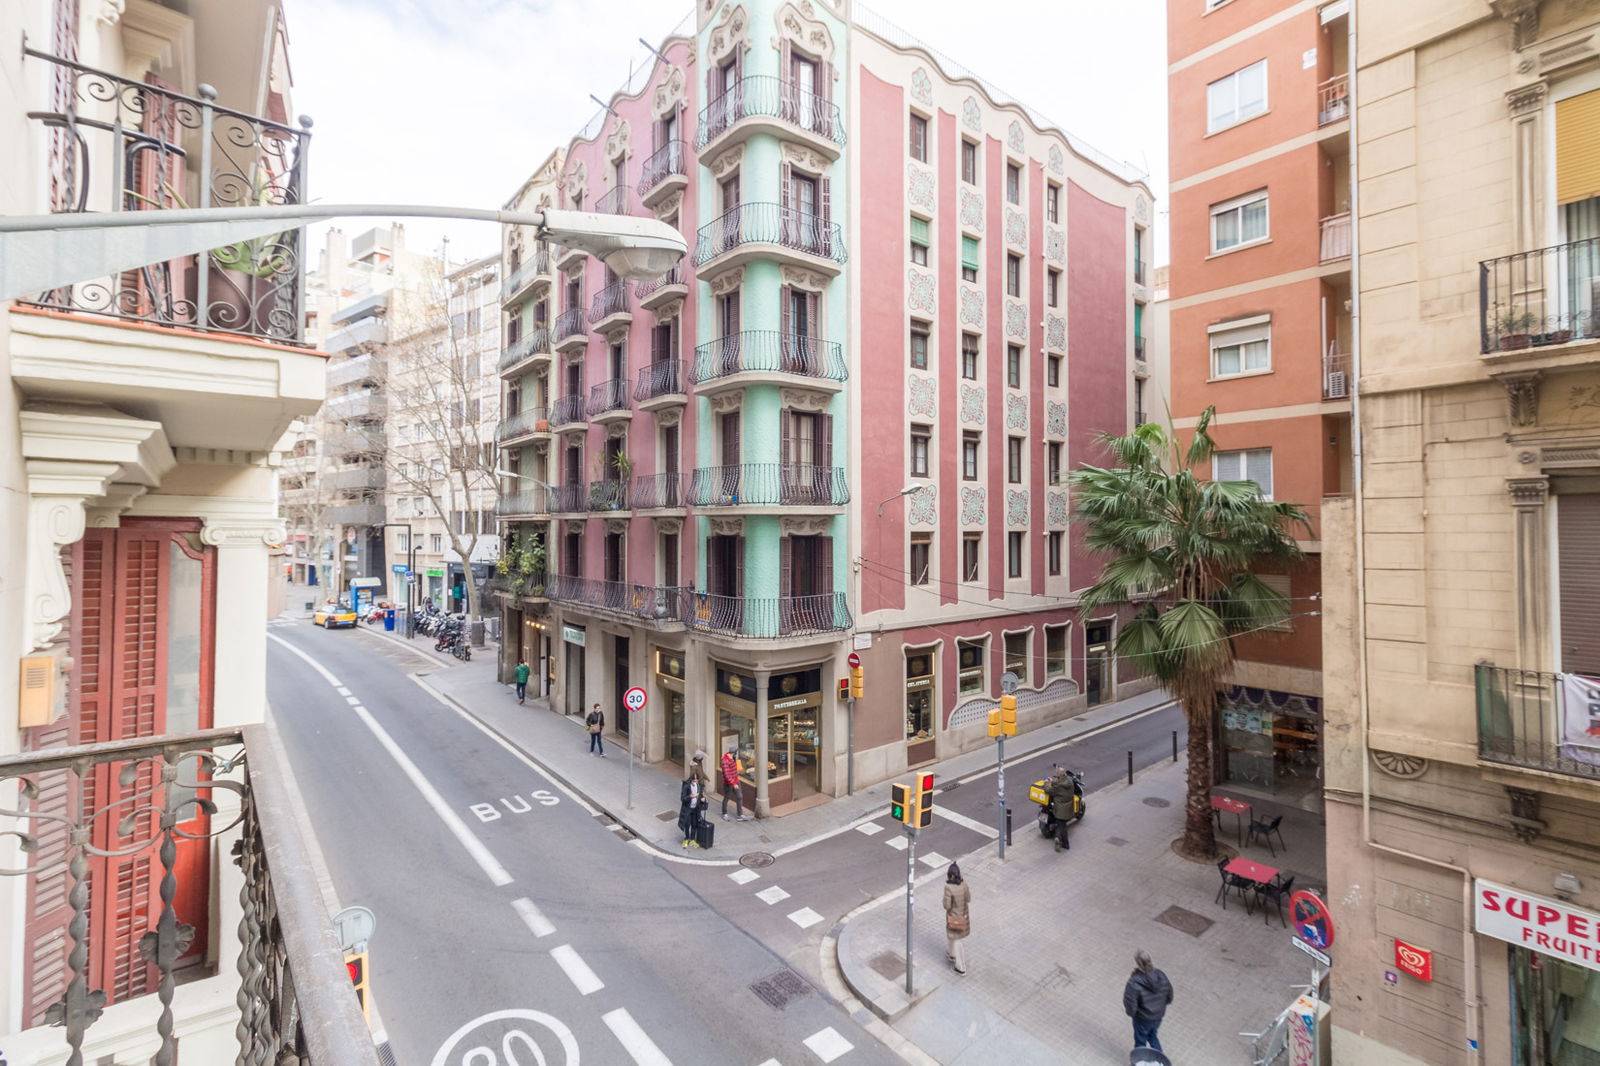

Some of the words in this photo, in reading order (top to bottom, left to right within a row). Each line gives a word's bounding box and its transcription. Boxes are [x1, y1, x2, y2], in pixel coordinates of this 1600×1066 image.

[629, 695, 643, 704] 30
[469, 790, 560, 823] BUS
[1482, 889, 1600, 943] SUPE
